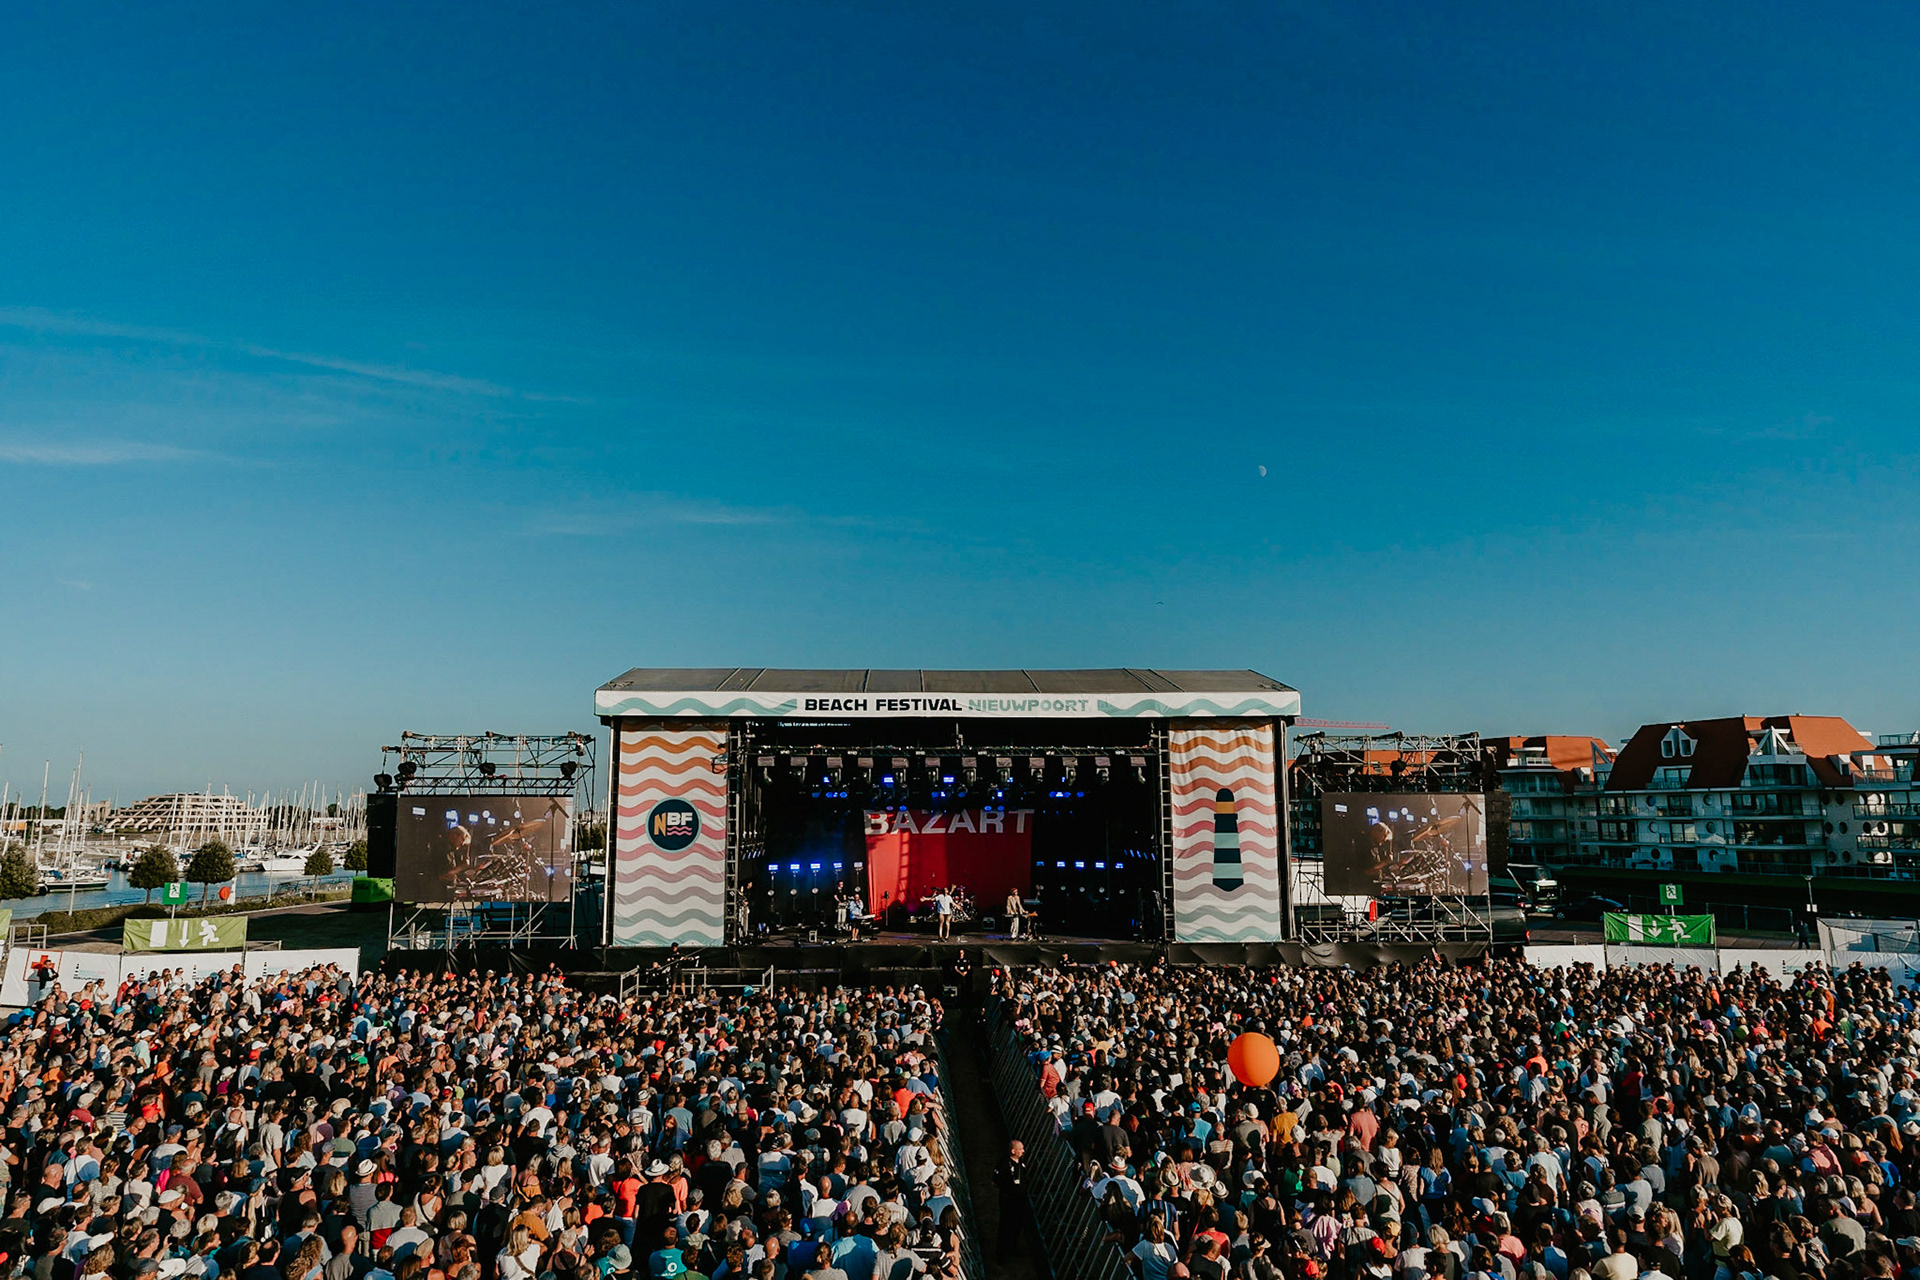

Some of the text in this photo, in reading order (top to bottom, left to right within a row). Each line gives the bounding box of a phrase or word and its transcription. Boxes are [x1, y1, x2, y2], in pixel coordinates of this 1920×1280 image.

[805, 699, 1088, 712] BEACH FESTIVAL NIEUWPOORT
[654, 812, 692, 836] NBF
[863, 809, 1035, 835] BAZART
